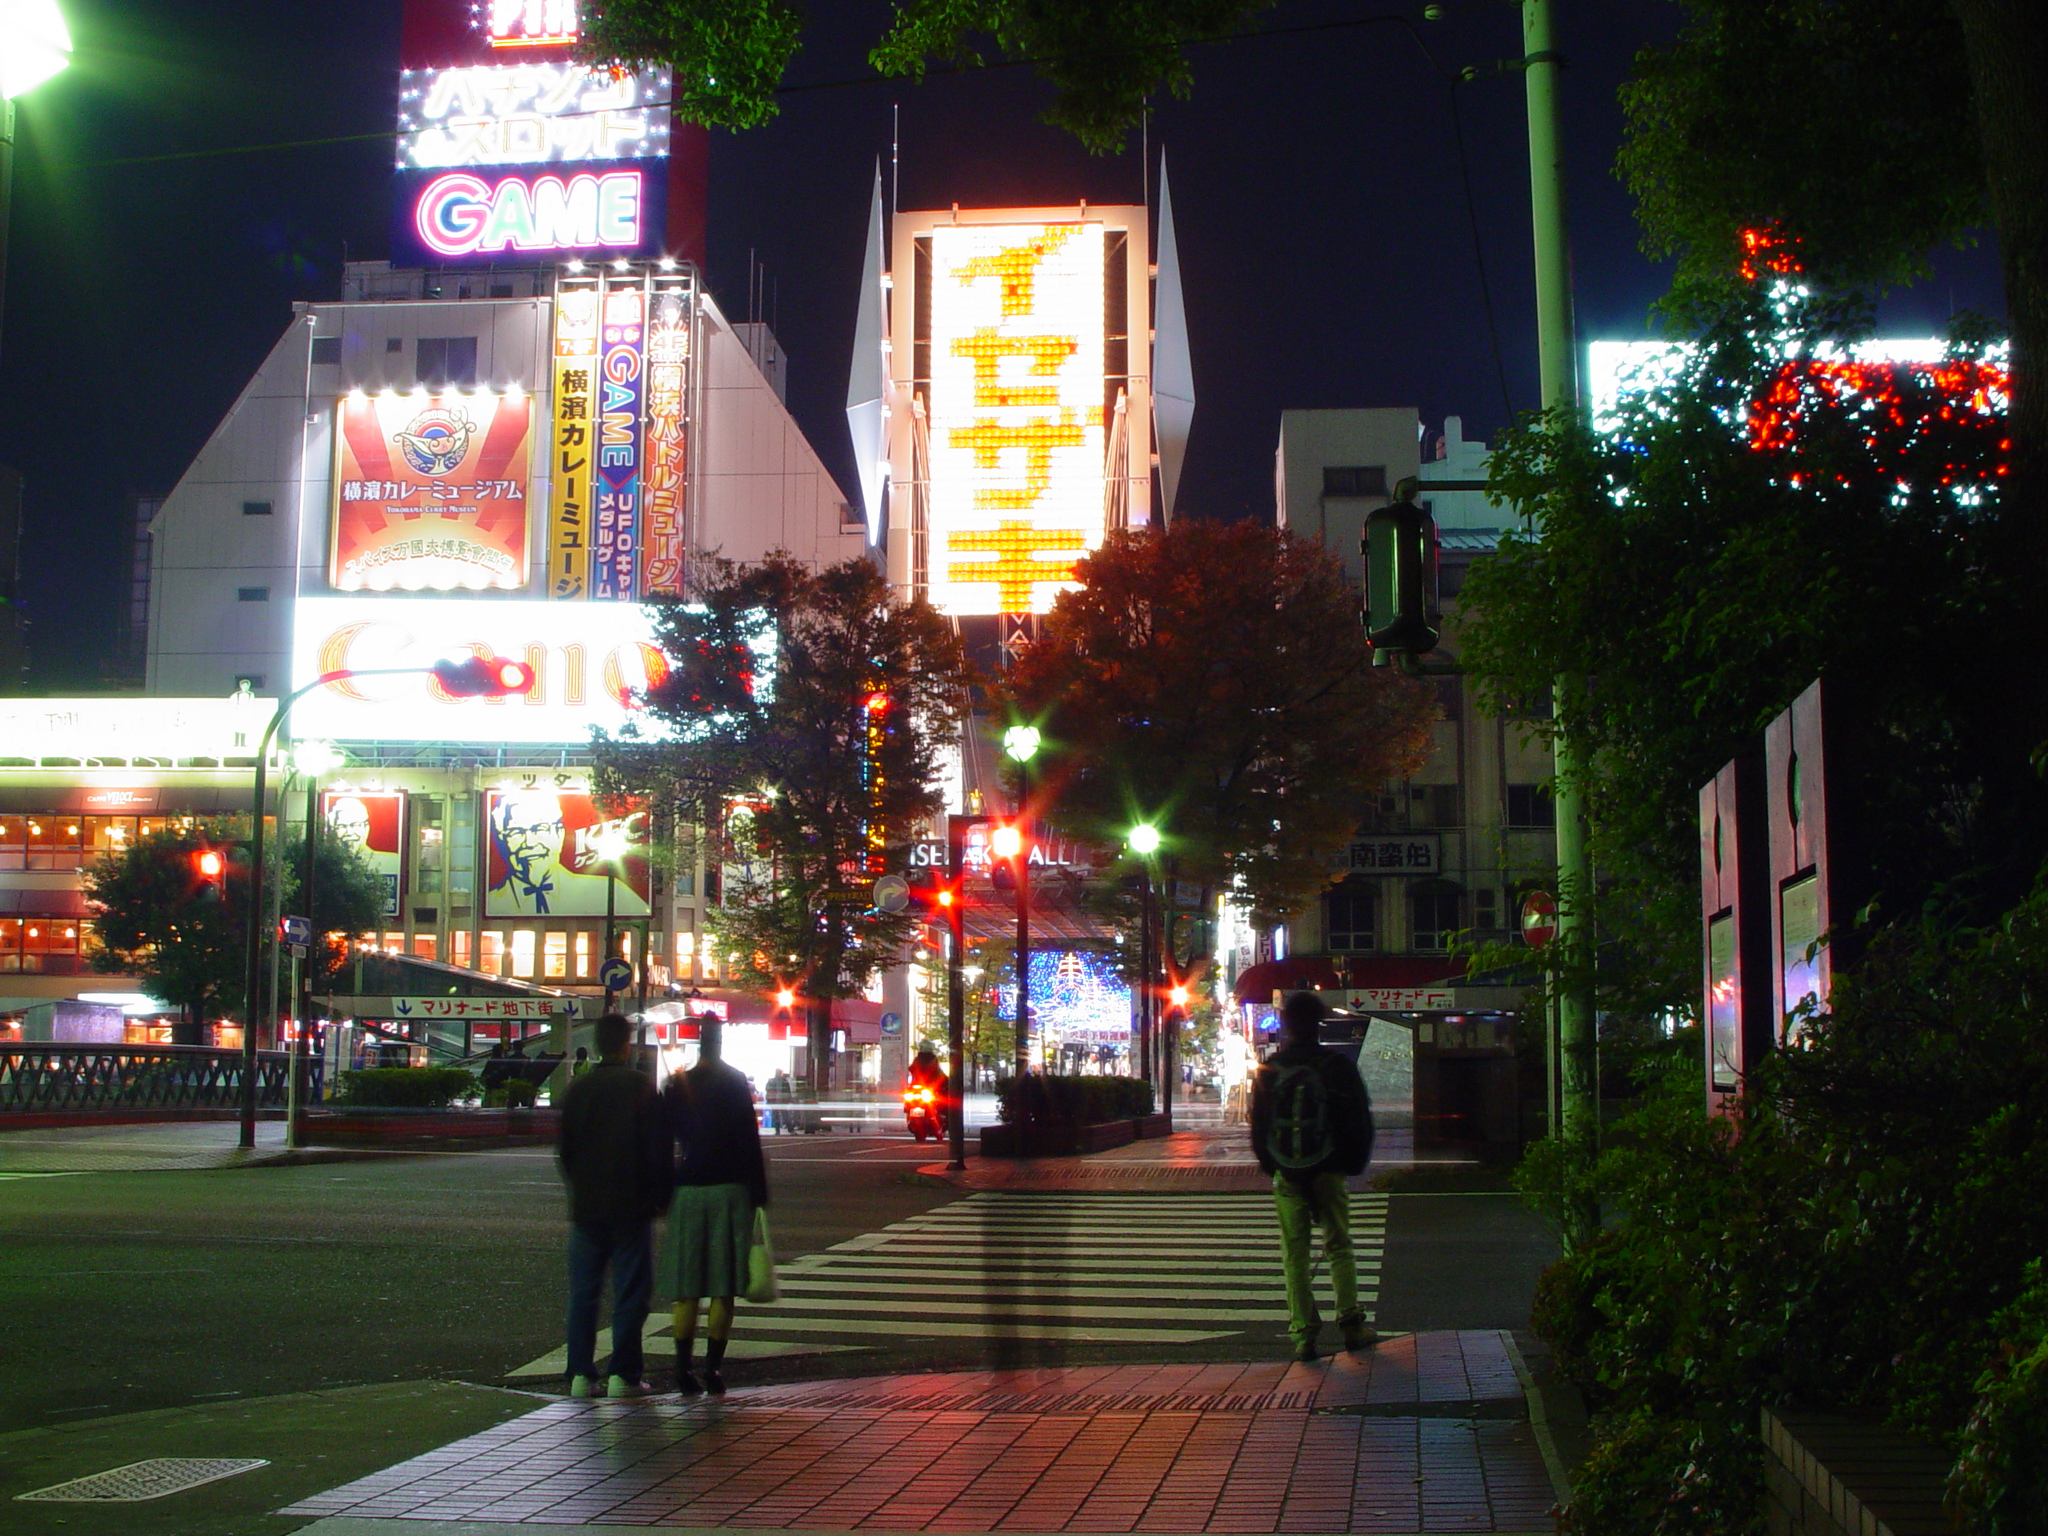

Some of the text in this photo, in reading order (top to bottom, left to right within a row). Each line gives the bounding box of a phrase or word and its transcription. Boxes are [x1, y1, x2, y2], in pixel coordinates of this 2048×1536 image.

[416, 172, 641, 255] GAME
[601, 344, 642, 468] GAME
[946, 225, 1104, 614] イセザキ
[343, 481, 523, 502] 横濱カレーミュージアム
[449, 505, 477, 514] MUSEUM
[650, 366, 682, 593] 横浜バトルミュージ
[597, 493, 615, 599] メダルゲーム
[574, 811, 647, 855] KFC
[420, 999, 554, 1016] マリナード地下街
[1369, 991, 1425, 1001] マリナード
